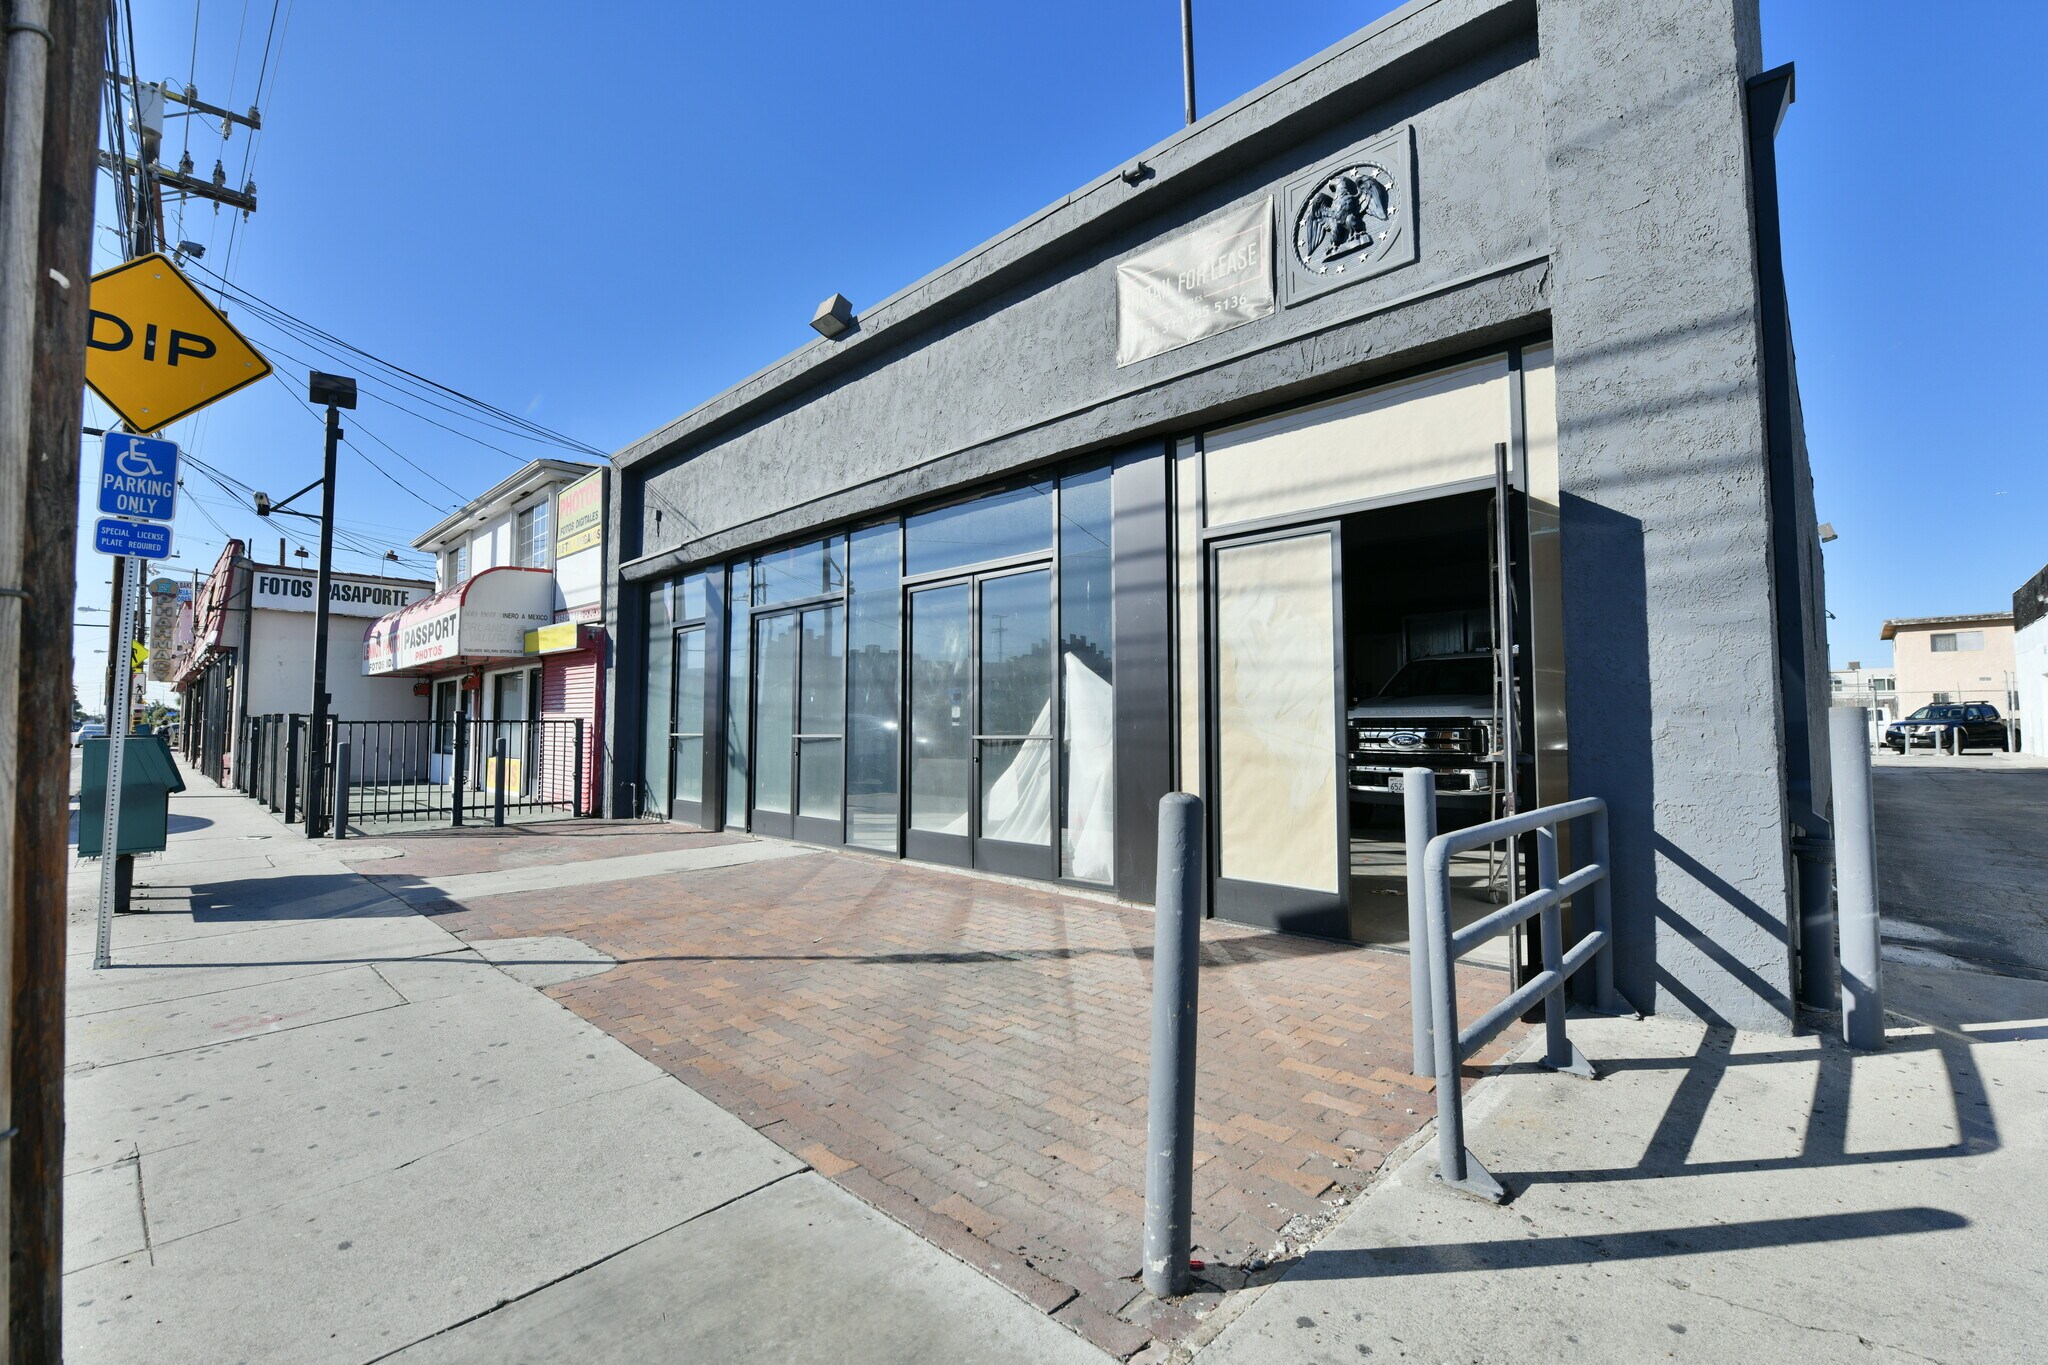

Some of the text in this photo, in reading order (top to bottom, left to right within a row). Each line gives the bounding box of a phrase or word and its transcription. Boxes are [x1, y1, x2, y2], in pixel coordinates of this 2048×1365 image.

[1177, 262, 1206, 293] FOR
[1211, 242, 1257, 281] LEASE
[1214, 292, 1247, 314] 5136
[87, 309, 217, 367] DIP
[103, 473, 172, 498] PARKING
[116, 494, 158, 514] ONLY
[559, 479, 601, 518] PHOTOS
[101, 526, 165, 542] SPECIAL LICENSE
[560, 510, 599, 536] FOTOS DIGITALES
[101, 537, 162, 552] PLATE REQUIRED
[259, 576, 313, 598] FOTOS
[328, 584, 410, 607] ASAPORTE
[527, 613, 548, 621] MEXICO
[152, 595, 173, 680] PHARMACY
[404, 613, 457, 650] PASSPORT
[415, 645, 443, 661] PHOTOS
[369, 661, 385, 672] FOTOS
[1396, 738, 1413, 746] Ford
